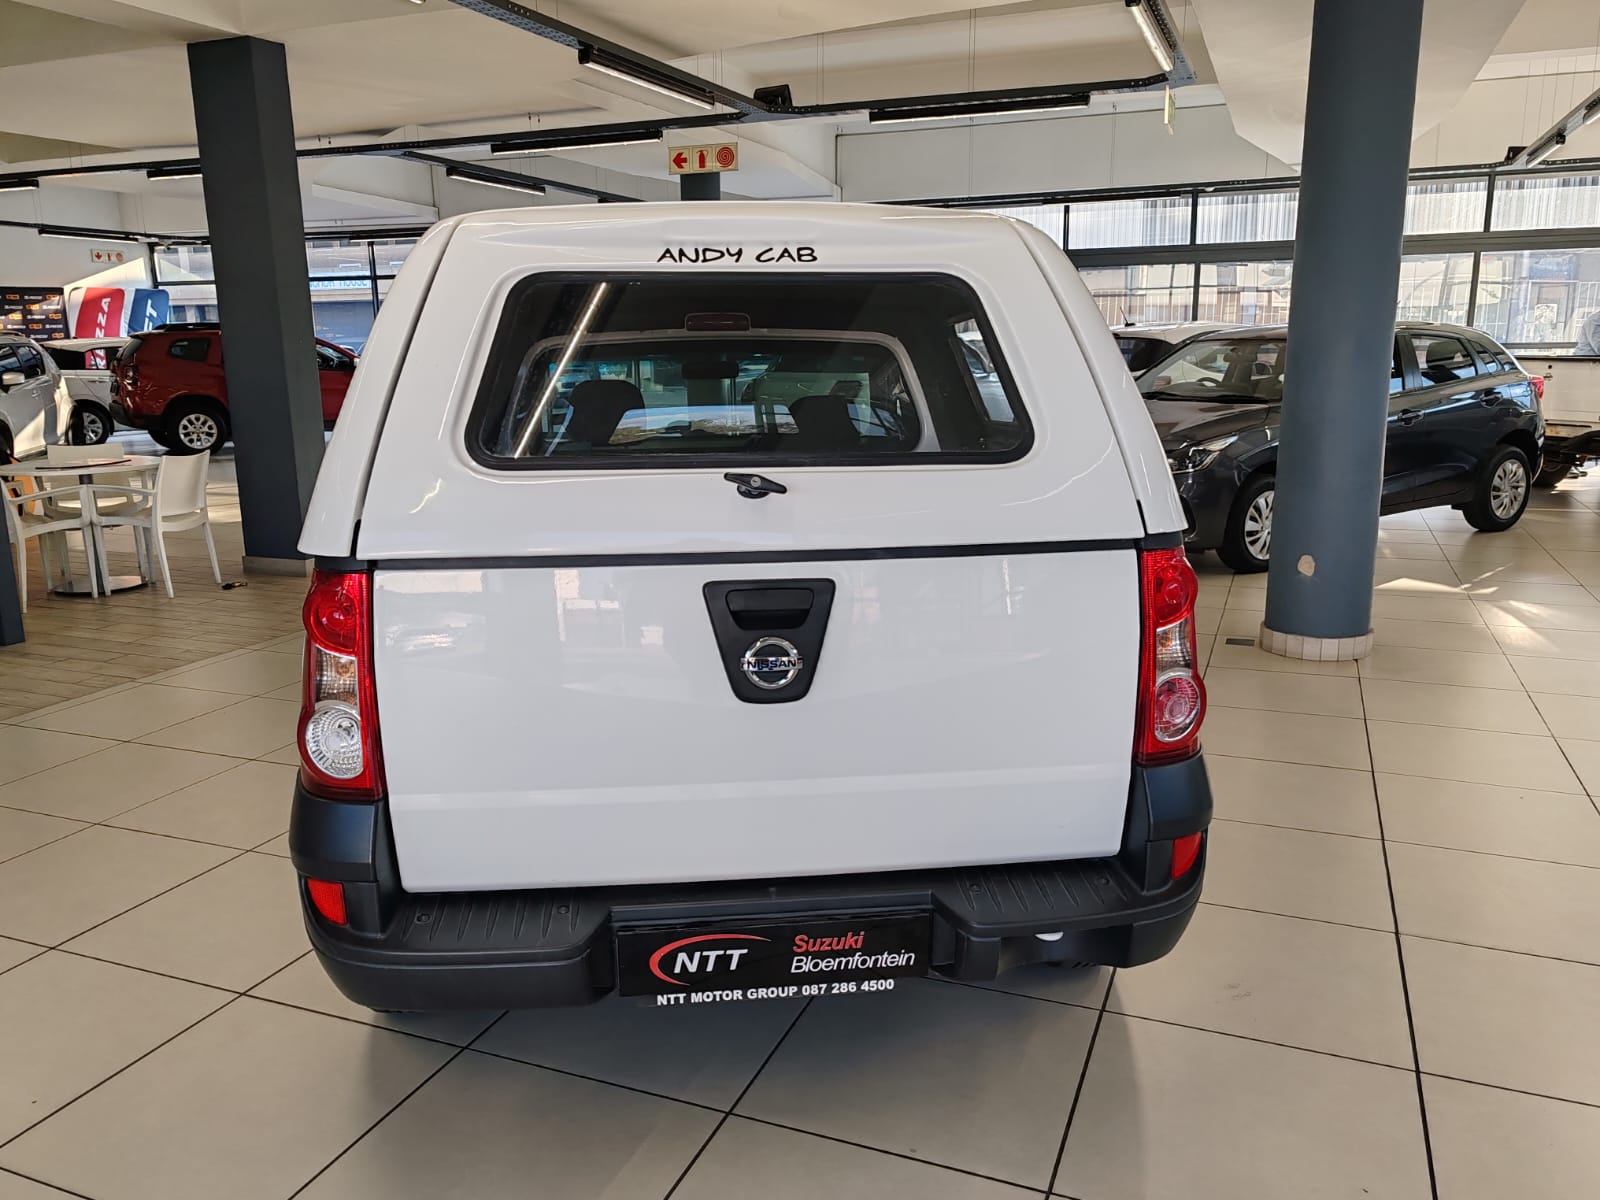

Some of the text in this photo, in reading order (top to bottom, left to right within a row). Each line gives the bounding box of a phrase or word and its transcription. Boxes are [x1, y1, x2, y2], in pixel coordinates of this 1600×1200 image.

[657, 246, 818, 263] ANDY CAB
[746, 659, 797, 671] NISSAN
[793, 931, 865, 953] Suzuki
[673, 949, 748, 974] NTT
[790, 949, 916, 974] Bloemfontein
[656, 978, 895, 1007] NTT MOTOR GROUP 087 286 4500
